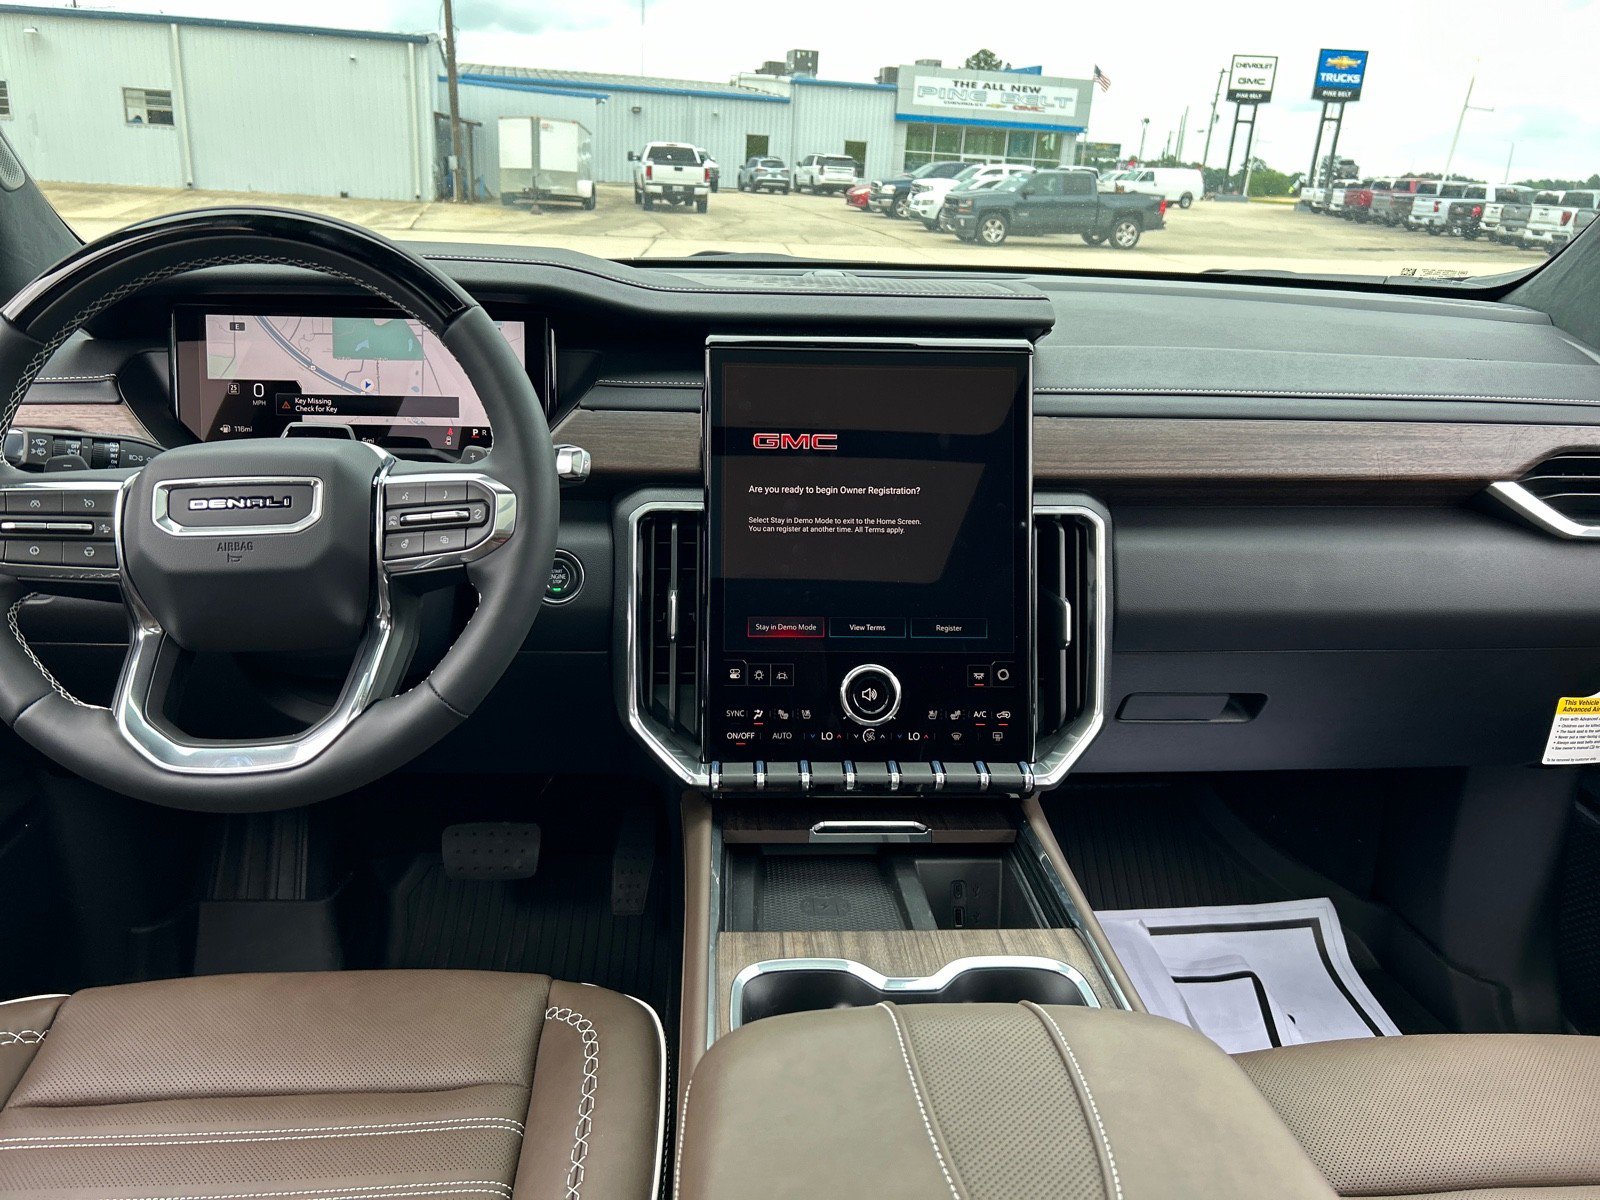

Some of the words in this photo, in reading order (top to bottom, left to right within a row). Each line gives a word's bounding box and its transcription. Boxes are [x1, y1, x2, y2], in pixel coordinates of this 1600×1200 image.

[1235, 61, 1273, 70] CHEVROLET
[1237, 77, 1266, 86] GMC
[1320, 72, 1361, 84] TRUCKS
[952, 79, 978, 91] THE
[984, 81, 1005, 92] ALL
[1011, 83, 1042, 94] NEW
[917, 85, 988, 103] PINE
[1000, 92, 1074, 109] BELT
[1337, 90, 1352, 98] BELT
[1012, 104, 1045, 113] GMC
[253, 383, 265, 398] 0
[295, 397, 307, 405] Key
[307, 397, 332, 406] Missing
[295, 405, 315, 413] Check
[315, 405, 325, 413] for
[325, 406, 338, 414] Key
[472, 428, 479, 436] P
[752, 432, 838, 450] GMC
[748, 485, 763, 493] Are
[764, 487, 780, 495] you
[781, 485, 804, 495] ready
[805, 486, 814, 494] to
[815, 486, 839, 496] begin
[839, 486, 866, 495] Owner
[868, 486, 921, 497] Registration?
[188, 496, 292, 511] DENALI
[748, 516, 770, 524] Select
[770, 516, 786, 525] Stay
[793, 517, 814, 525] Demo
[814, 517, 834, 525] Mode
[842, 517, 855, 525] exit
[864, 517, 875, 525] the
[876, 518, 897, 526] Home
[897, 518, 922, 526] Screen.
[776, 525, 801, 533] register
[810, 525, 835, 533] another
[836, 525, 853, 533] time.
[865, 526, 885, 534] Terms
[886, 527, 906, 535] apply.
[216, 541, 253, 551] AIRBAG
[755, 623, 770, 632] Stay
[770, 623, 777, 631] in
[777, 623, 797, 631] Demo
[798, 623, 817, 632] Mode
[849, 623, 865, 632] View
[866, 624, 886, 632] Terms
[935, 624, 962, 633] Register
[973, 710, 987, 718] A/C
[821, 732, 833, 740] LO
[908, 732, 920, 740] LO
